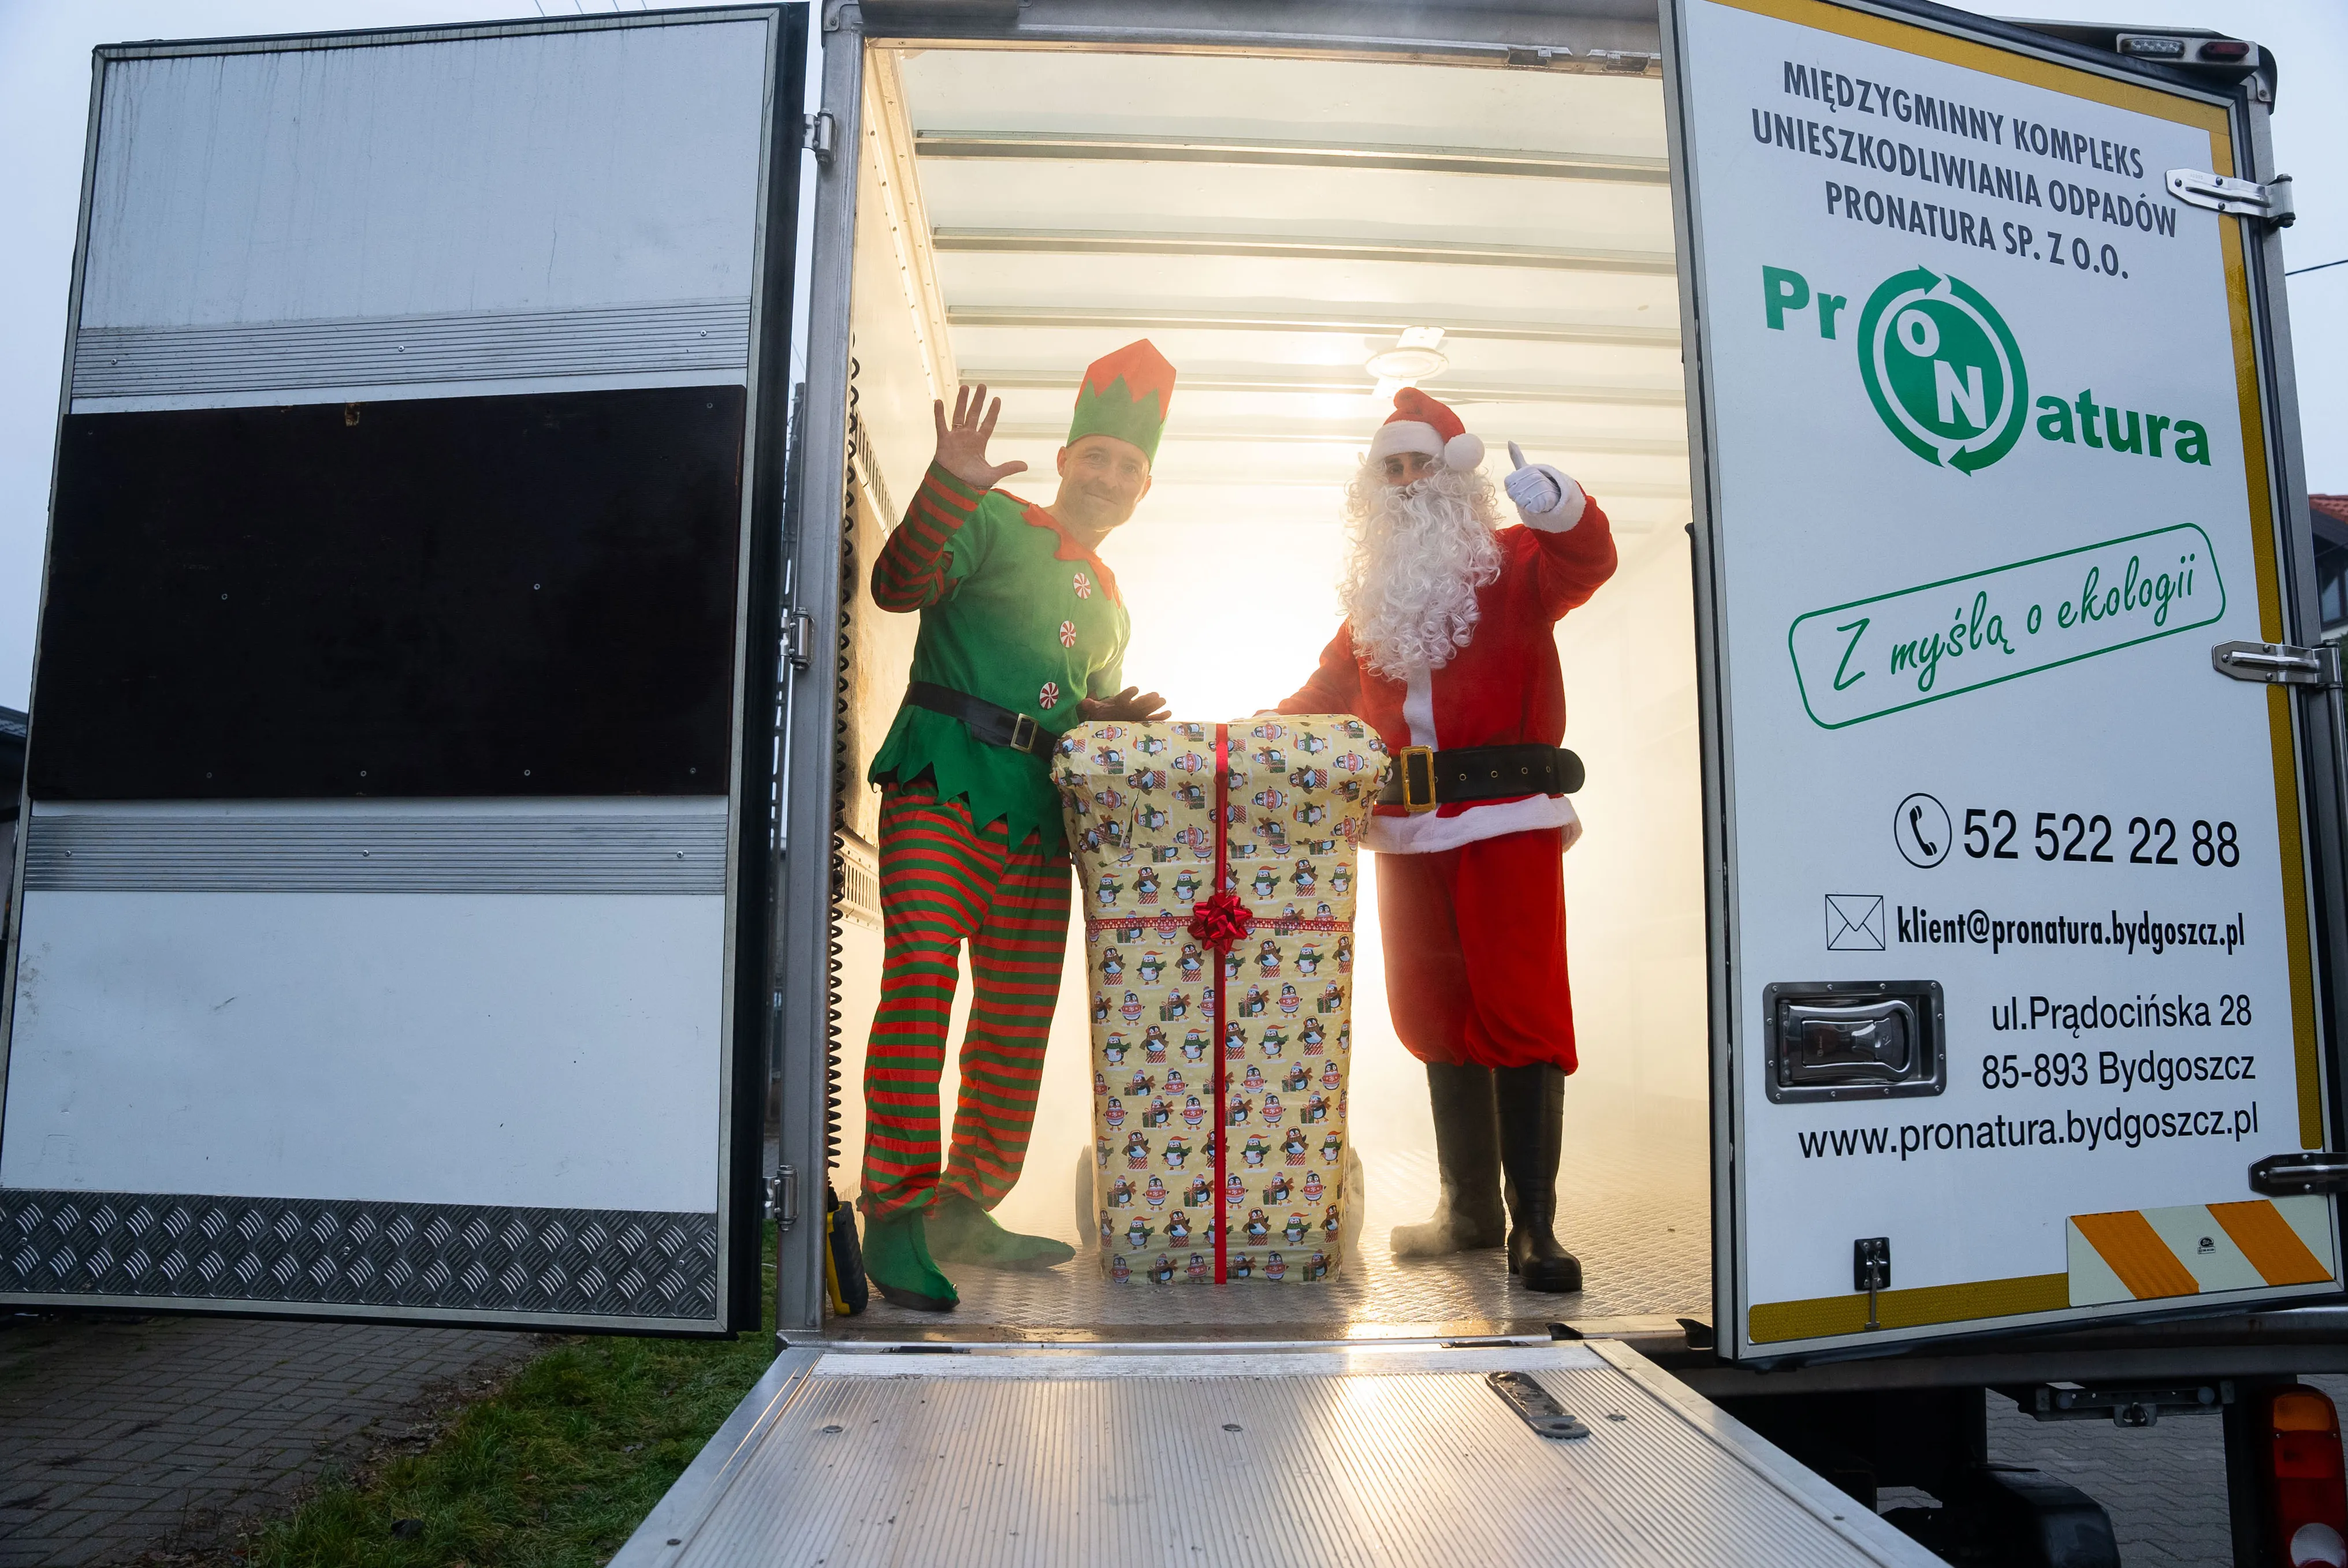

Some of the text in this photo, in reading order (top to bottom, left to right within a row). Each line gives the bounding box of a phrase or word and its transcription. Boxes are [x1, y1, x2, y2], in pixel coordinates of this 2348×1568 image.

[1784, 61, 2144, 180] MIĘDZYGMINNY KOMPLEKS
[1752, 108, 2176, 238] UNIESZKODLIWIANIA ODPADÓW
[1825, 180, 2129, 280] PRONATURA SP. Z O.O.
[1833, 553, 2196, 692] Z myślą o ekologii
[1963, 808, 2240, 868] 52 522 22 88
[1897, 906, 2245, 956] klient@pronatura.bydgoszcz.pl
[1992, 994, 2252, 1039] ul.Prądocińska 28
[1982, 1049, 2256, 1093] 85-893 Bydgoszcz
[1798, 1101, 2258, 1161] www.pronatura.bydgoszcz.pl
